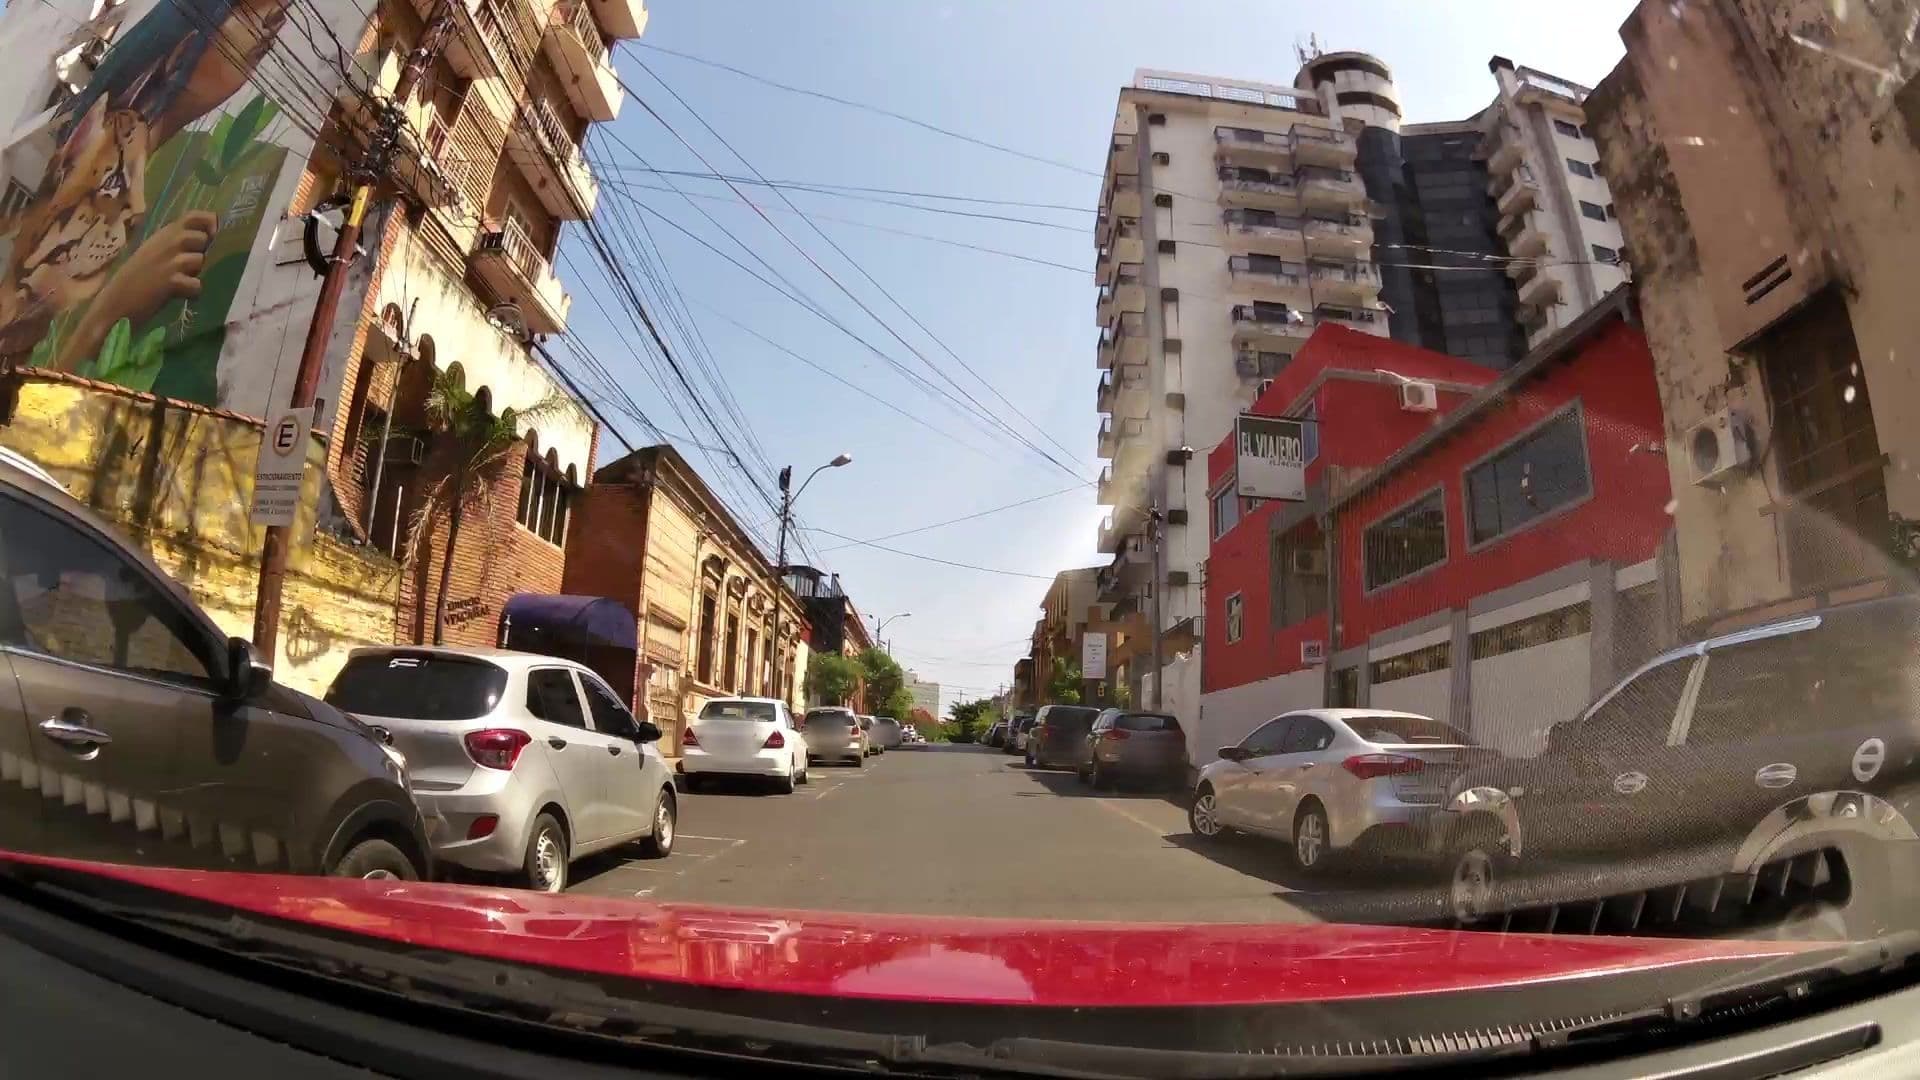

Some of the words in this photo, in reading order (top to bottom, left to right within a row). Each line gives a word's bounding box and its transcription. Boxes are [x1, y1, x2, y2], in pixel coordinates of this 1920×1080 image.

[277, 423, 295, 448] E
[1241, 431, 1254, 456] EL
[1255, 433, 1301, 464] VIAJERO
